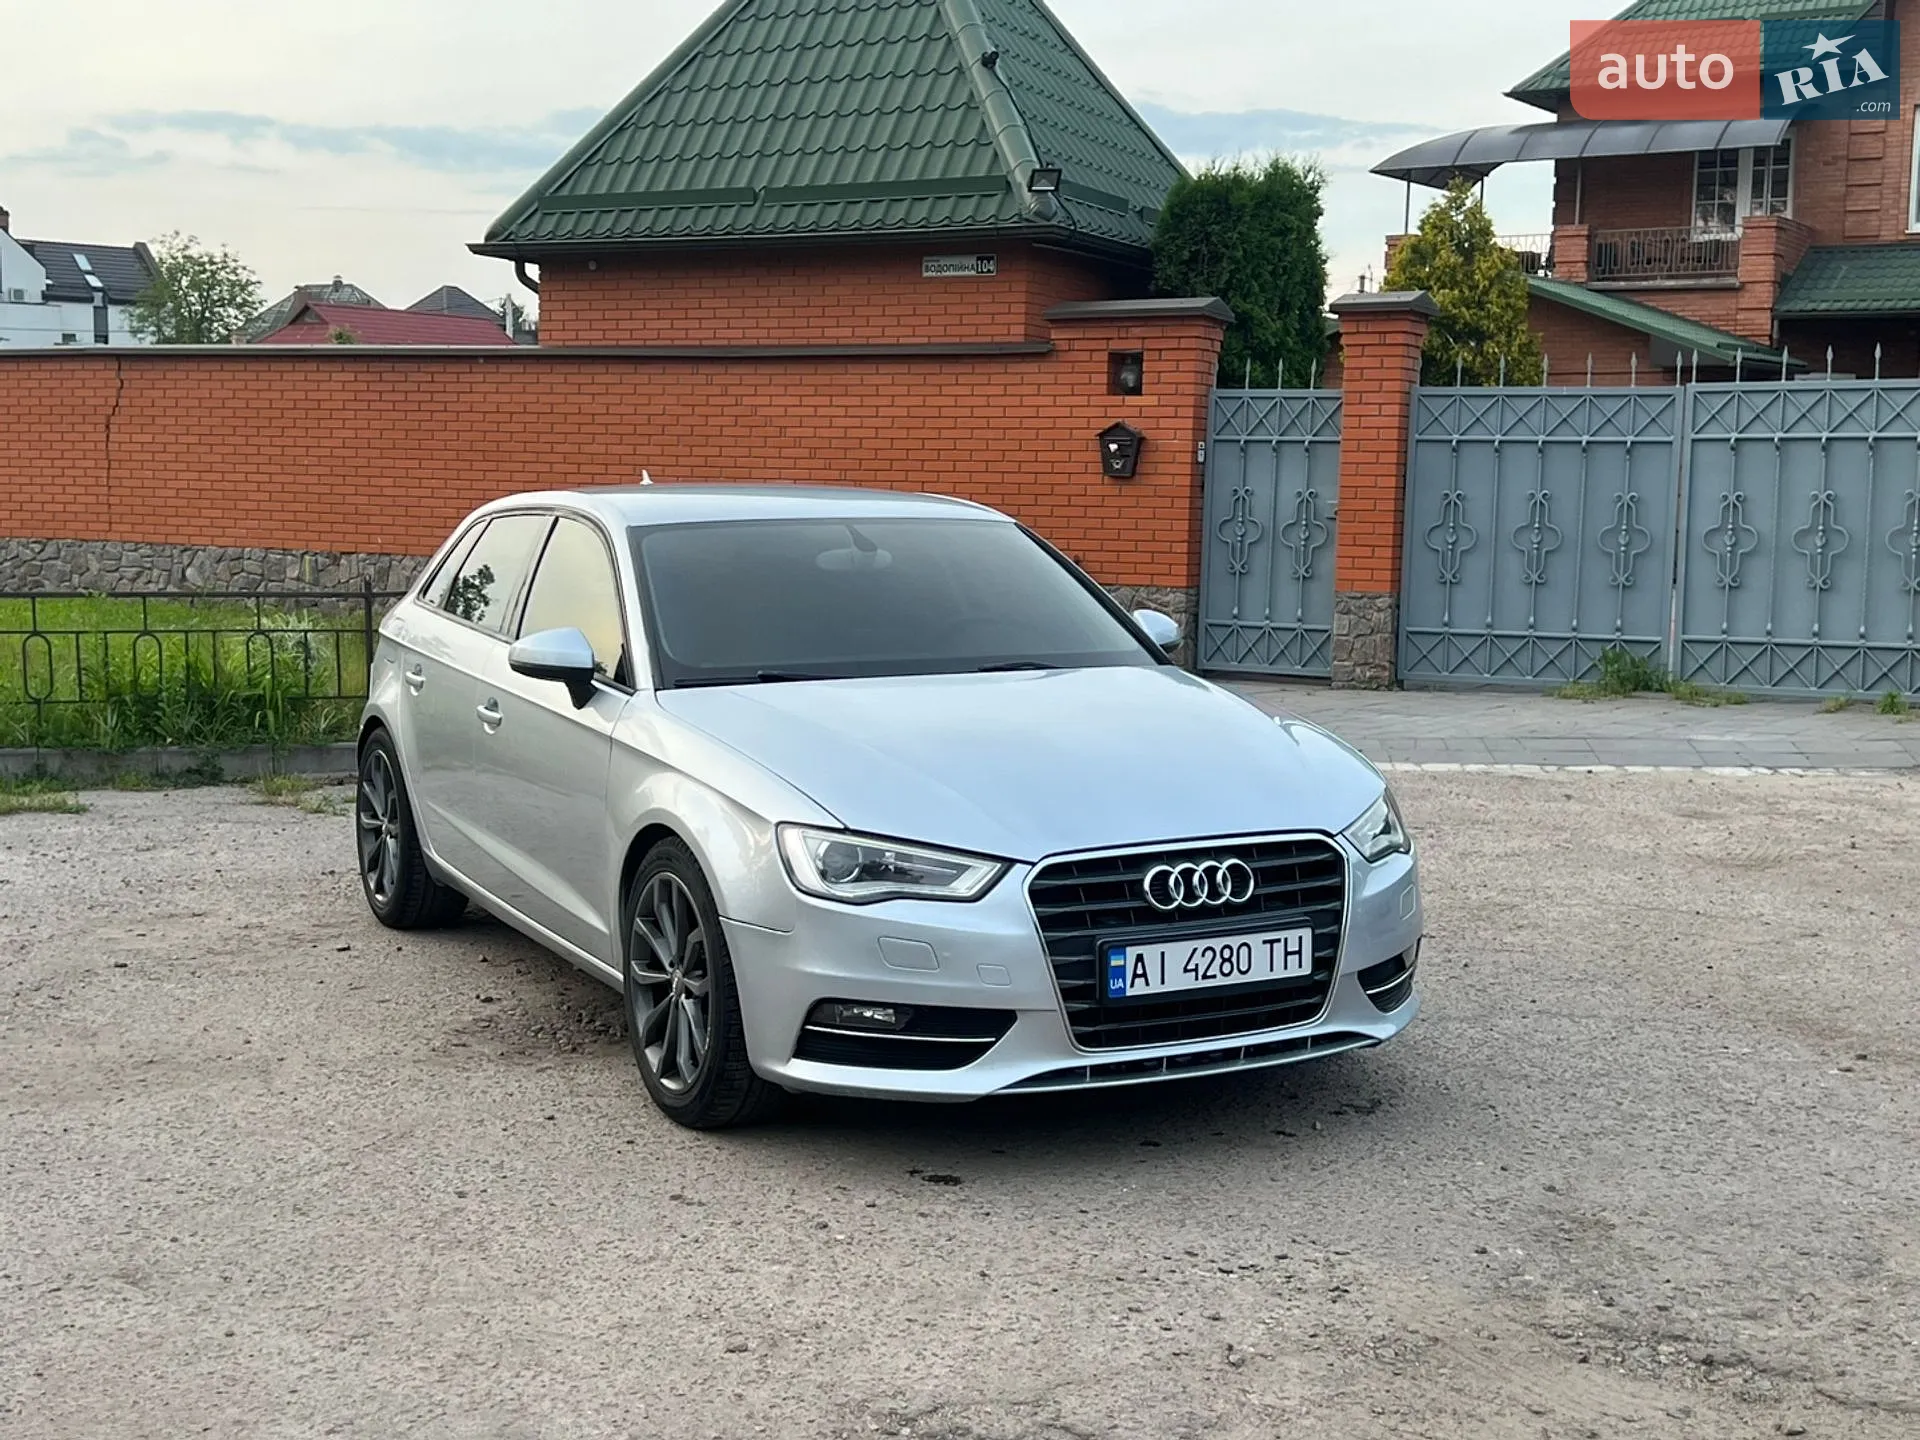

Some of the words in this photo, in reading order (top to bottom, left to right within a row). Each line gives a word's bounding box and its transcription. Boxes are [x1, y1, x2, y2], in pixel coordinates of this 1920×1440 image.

[924, 261, 976, 274] ВОДОПІЙНА
[1129, 951, 1166, 988] AI
[1182, 942, 1252, 981] 4280
[1262, 935, 1303, 972] TH
[1110, 978, 1124, 989] UA
